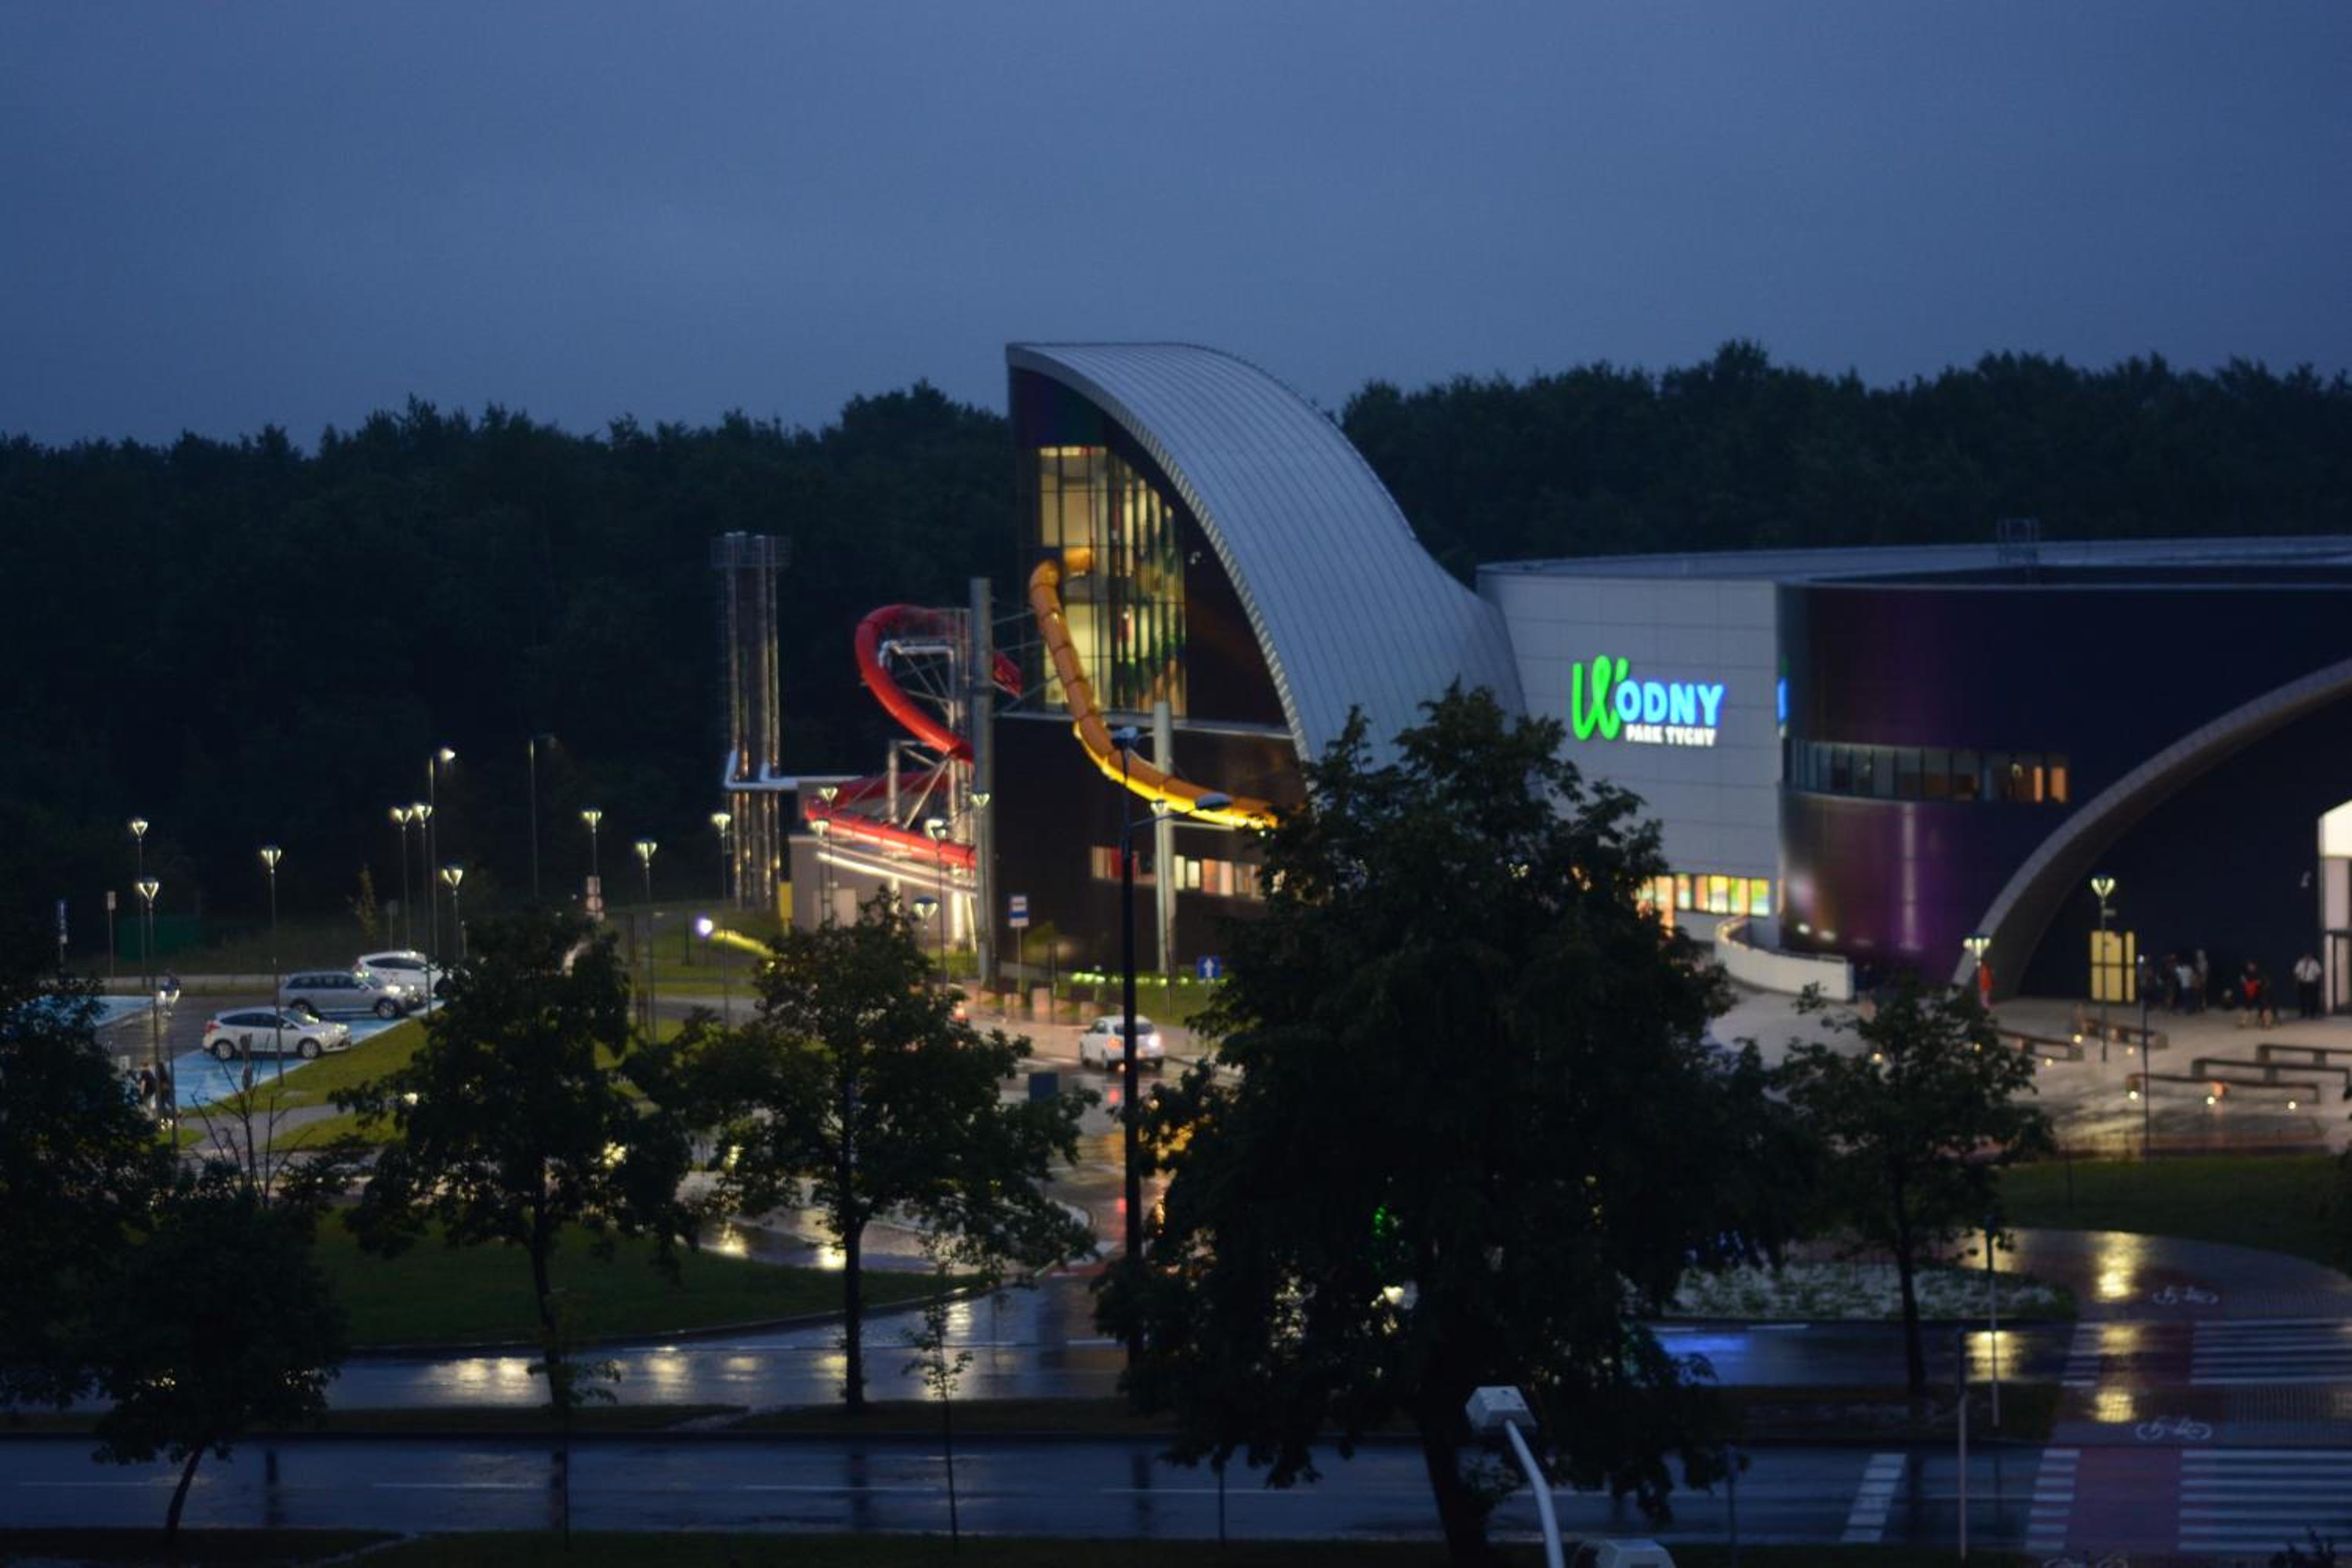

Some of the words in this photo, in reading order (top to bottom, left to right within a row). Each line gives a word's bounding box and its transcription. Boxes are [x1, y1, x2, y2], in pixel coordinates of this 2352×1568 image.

[1572, 655, 1724, 740] WODNY
[1626, 724, 1663, 744] PARK
[1664, 725, 1716, 746] TYCHY
